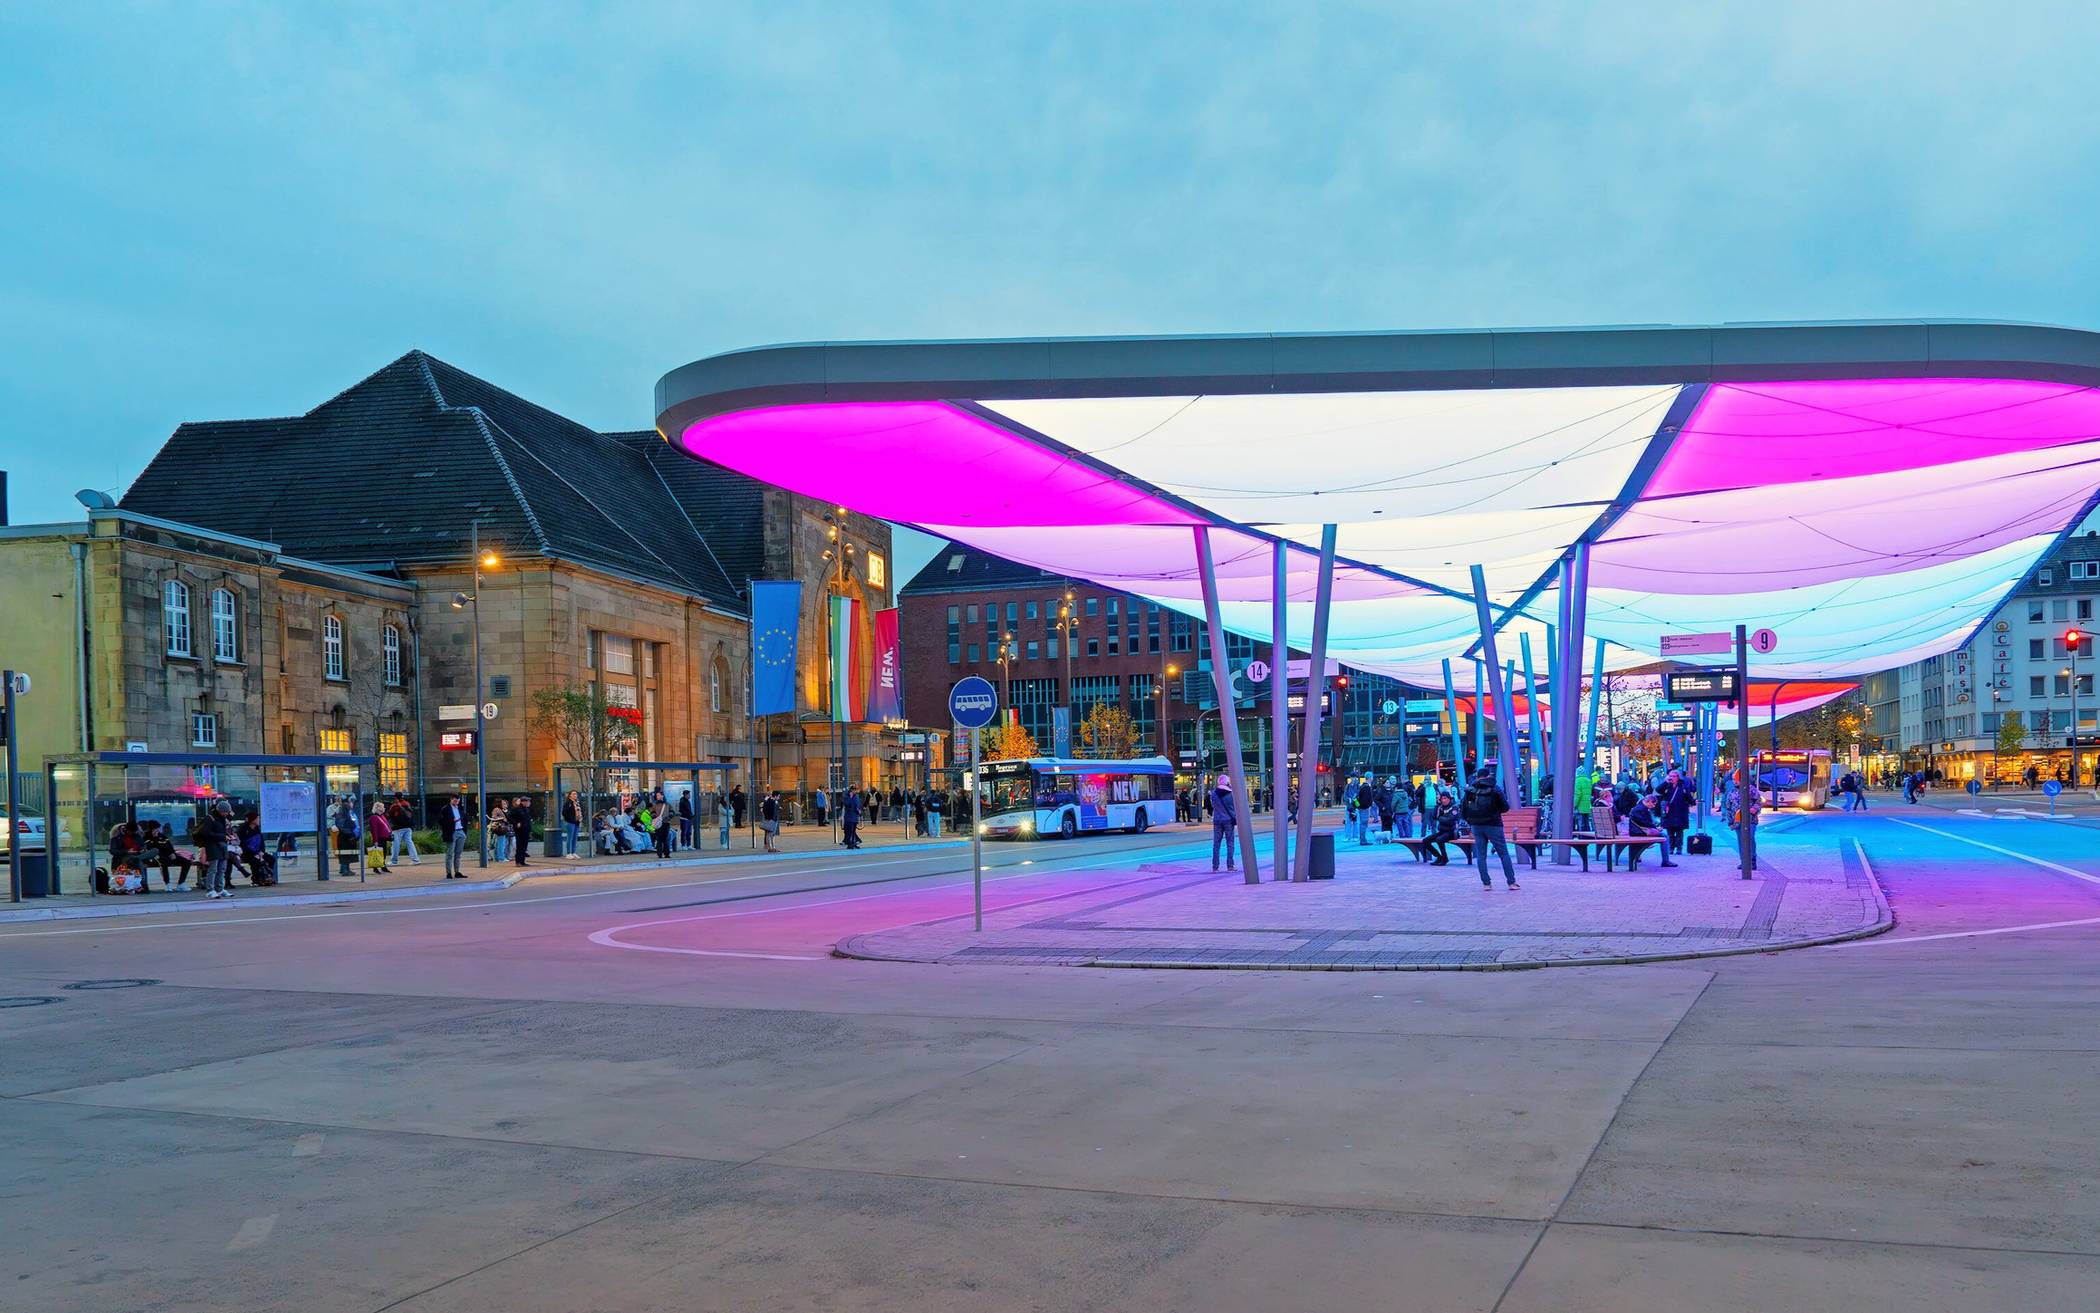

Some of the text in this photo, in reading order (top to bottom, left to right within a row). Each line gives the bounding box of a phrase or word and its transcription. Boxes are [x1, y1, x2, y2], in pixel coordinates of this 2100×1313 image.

[870, 557, 883, 584] DB
[1760, 632, 1769, 650] 9
[1251, 664, 1263, 679] 14
[15, 676, 25, 693] 20
[486, 705, 494, 717] 19
[1385, 702, 1395, 713] 13
